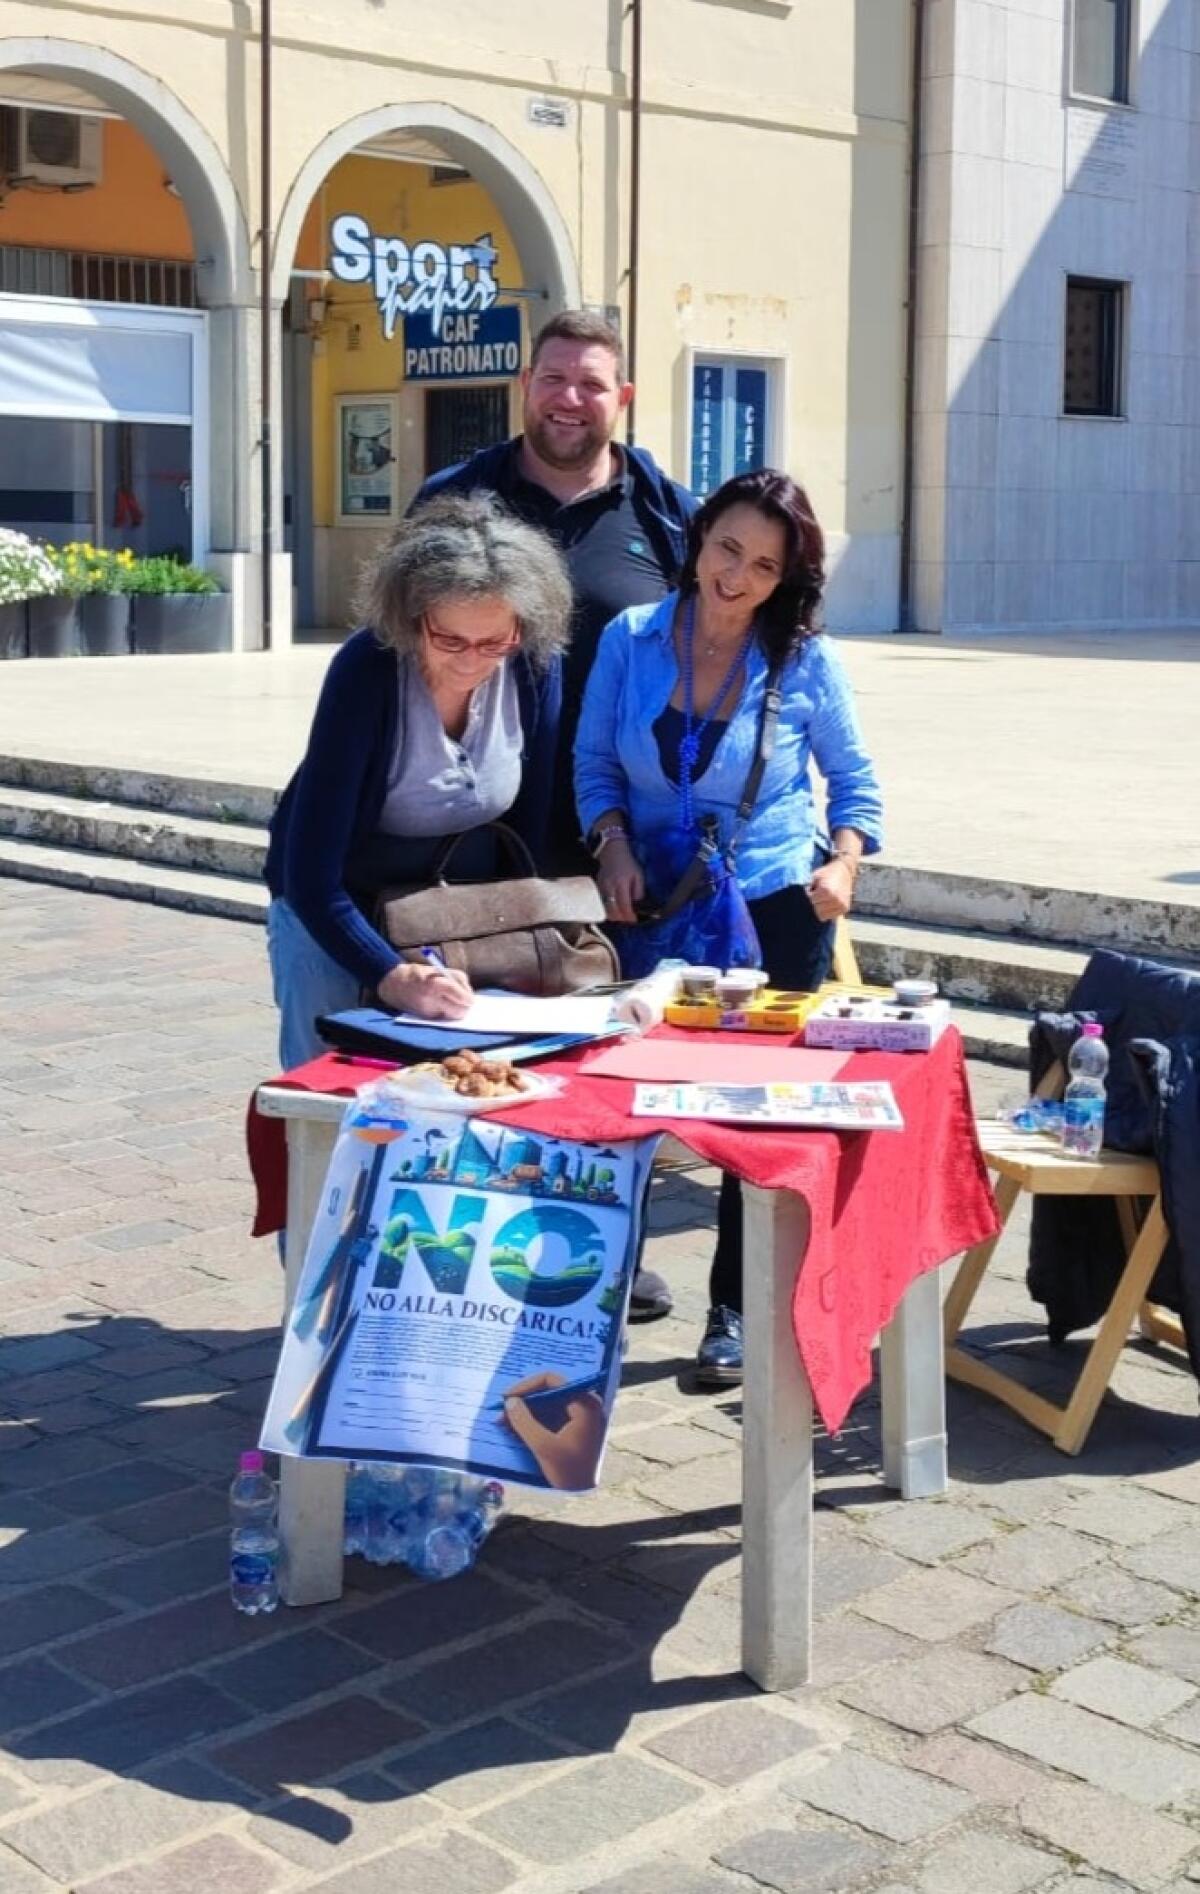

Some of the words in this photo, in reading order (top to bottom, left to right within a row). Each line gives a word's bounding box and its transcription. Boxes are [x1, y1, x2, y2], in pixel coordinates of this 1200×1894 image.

[331, 214, 499, 299] Sport
[380, 273, 499, 340] paper
[441, 313, 481, 344] CAF
[405, 342, 519, 376] PATRONATO
[744, 405, 755, 463] CAF
[372, 1188, 606, 1307] NO
[363, 1292, 396, 1311] NO
[399, 1296, 454, 1318] ALLA
[460, 1300, 595, 1339] DISCARICA!
